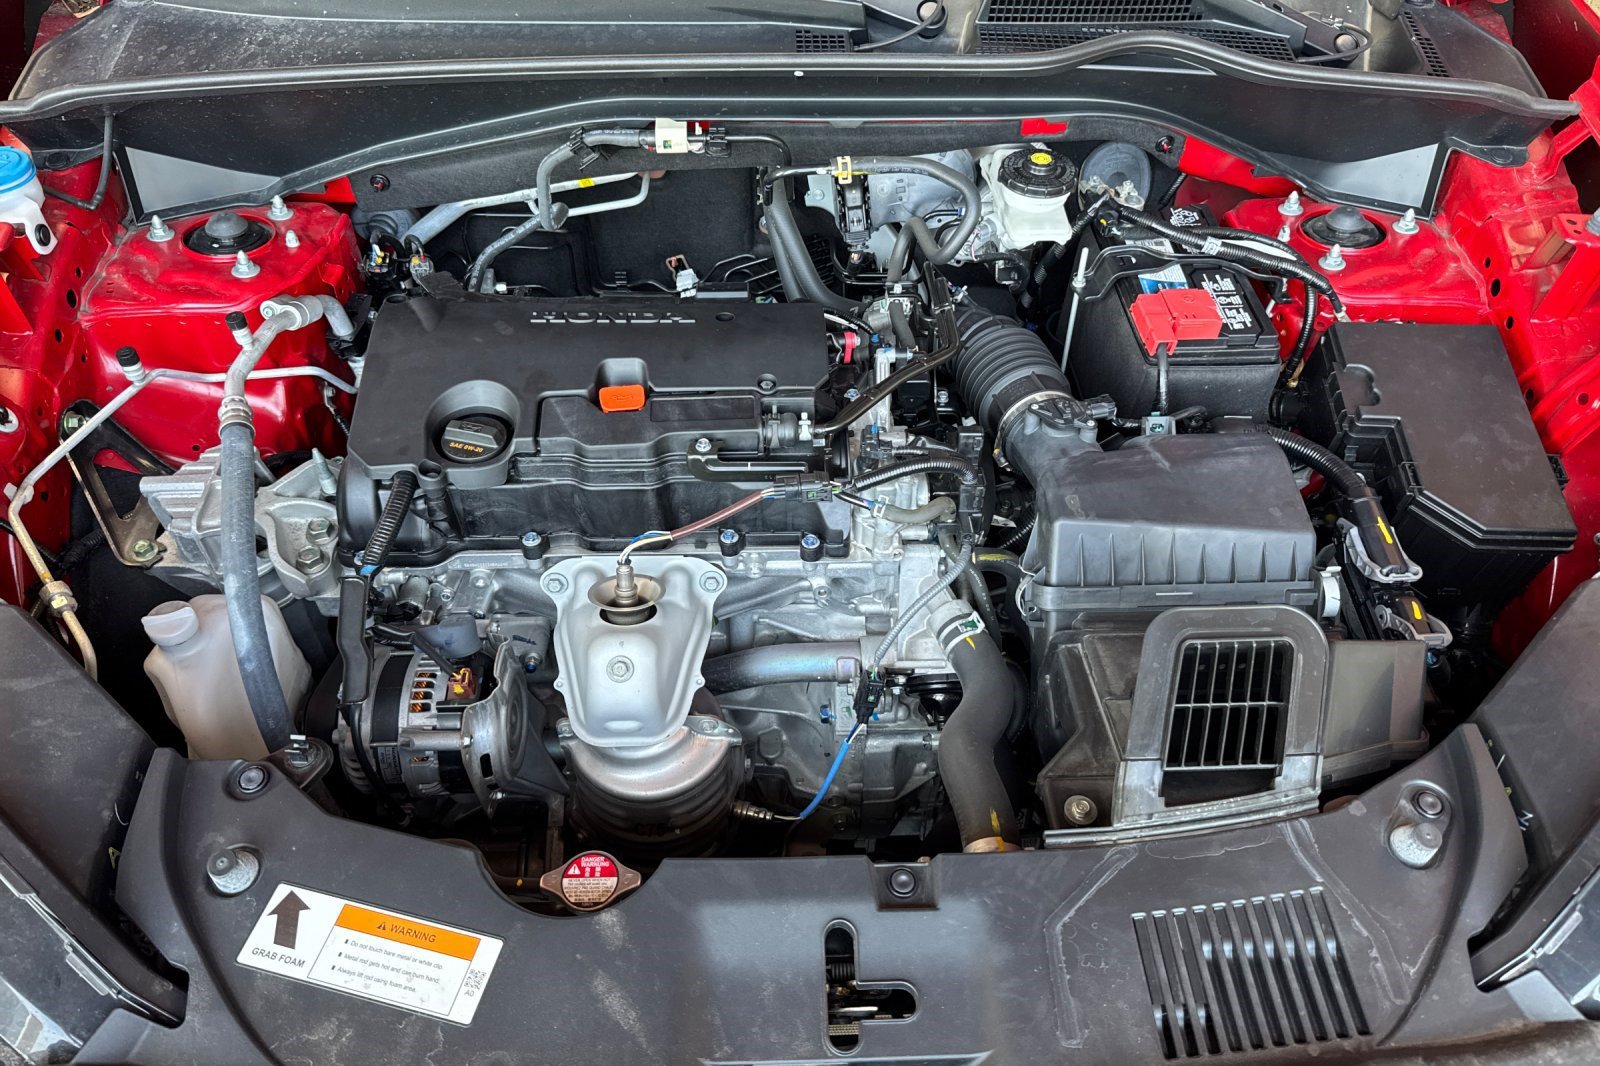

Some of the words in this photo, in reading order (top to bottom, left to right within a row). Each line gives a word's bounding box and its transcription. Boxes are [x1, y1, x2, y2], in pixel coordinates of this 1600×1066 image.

[530, 312, 696, 323] HONDA
[463, 444, 484, 453] 0W-20
[390, 924, 436, 943] WARNING
[368, 945, 383, 953] touch
[251, 947, 277, 961] GRAB
[278, 954, 306, 968] FOAM
[344, 953, 359, 961] Metal
[337, 966, 356, 976] Always
[374, 977, 388, 986] using
[389, 980, 403, 988] foam
